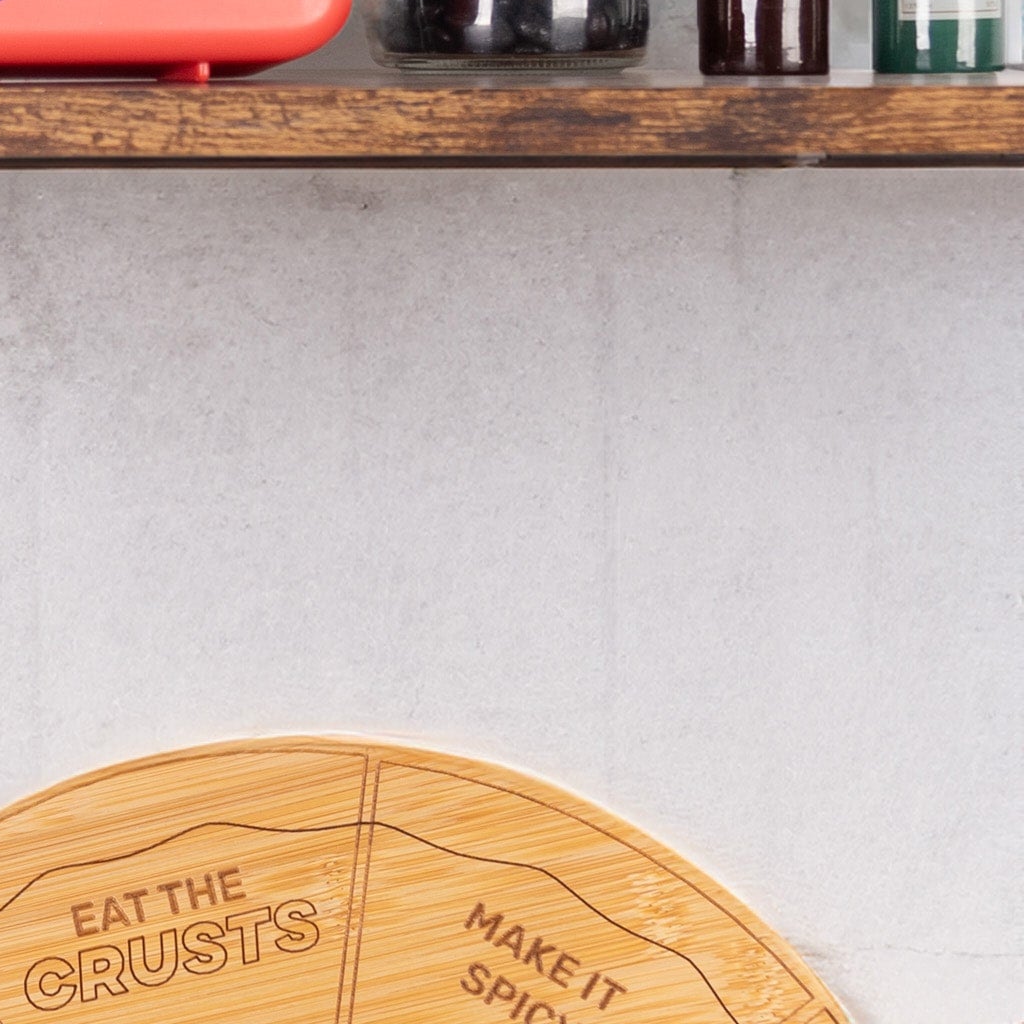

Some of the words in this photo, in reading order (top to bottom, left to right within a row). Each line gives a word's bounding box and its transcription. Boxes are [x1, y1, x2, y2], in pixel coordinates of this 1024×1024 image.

[71, 887, 149, 937] EAT
[156, 866, 247, 915] THE
[24, 899, 320, 1011] CRUSTS
[459, 961, 572, 1024] SPIC
[463, 902, 581, 989] MAKE
[580, 972, 628, 1011] IT
